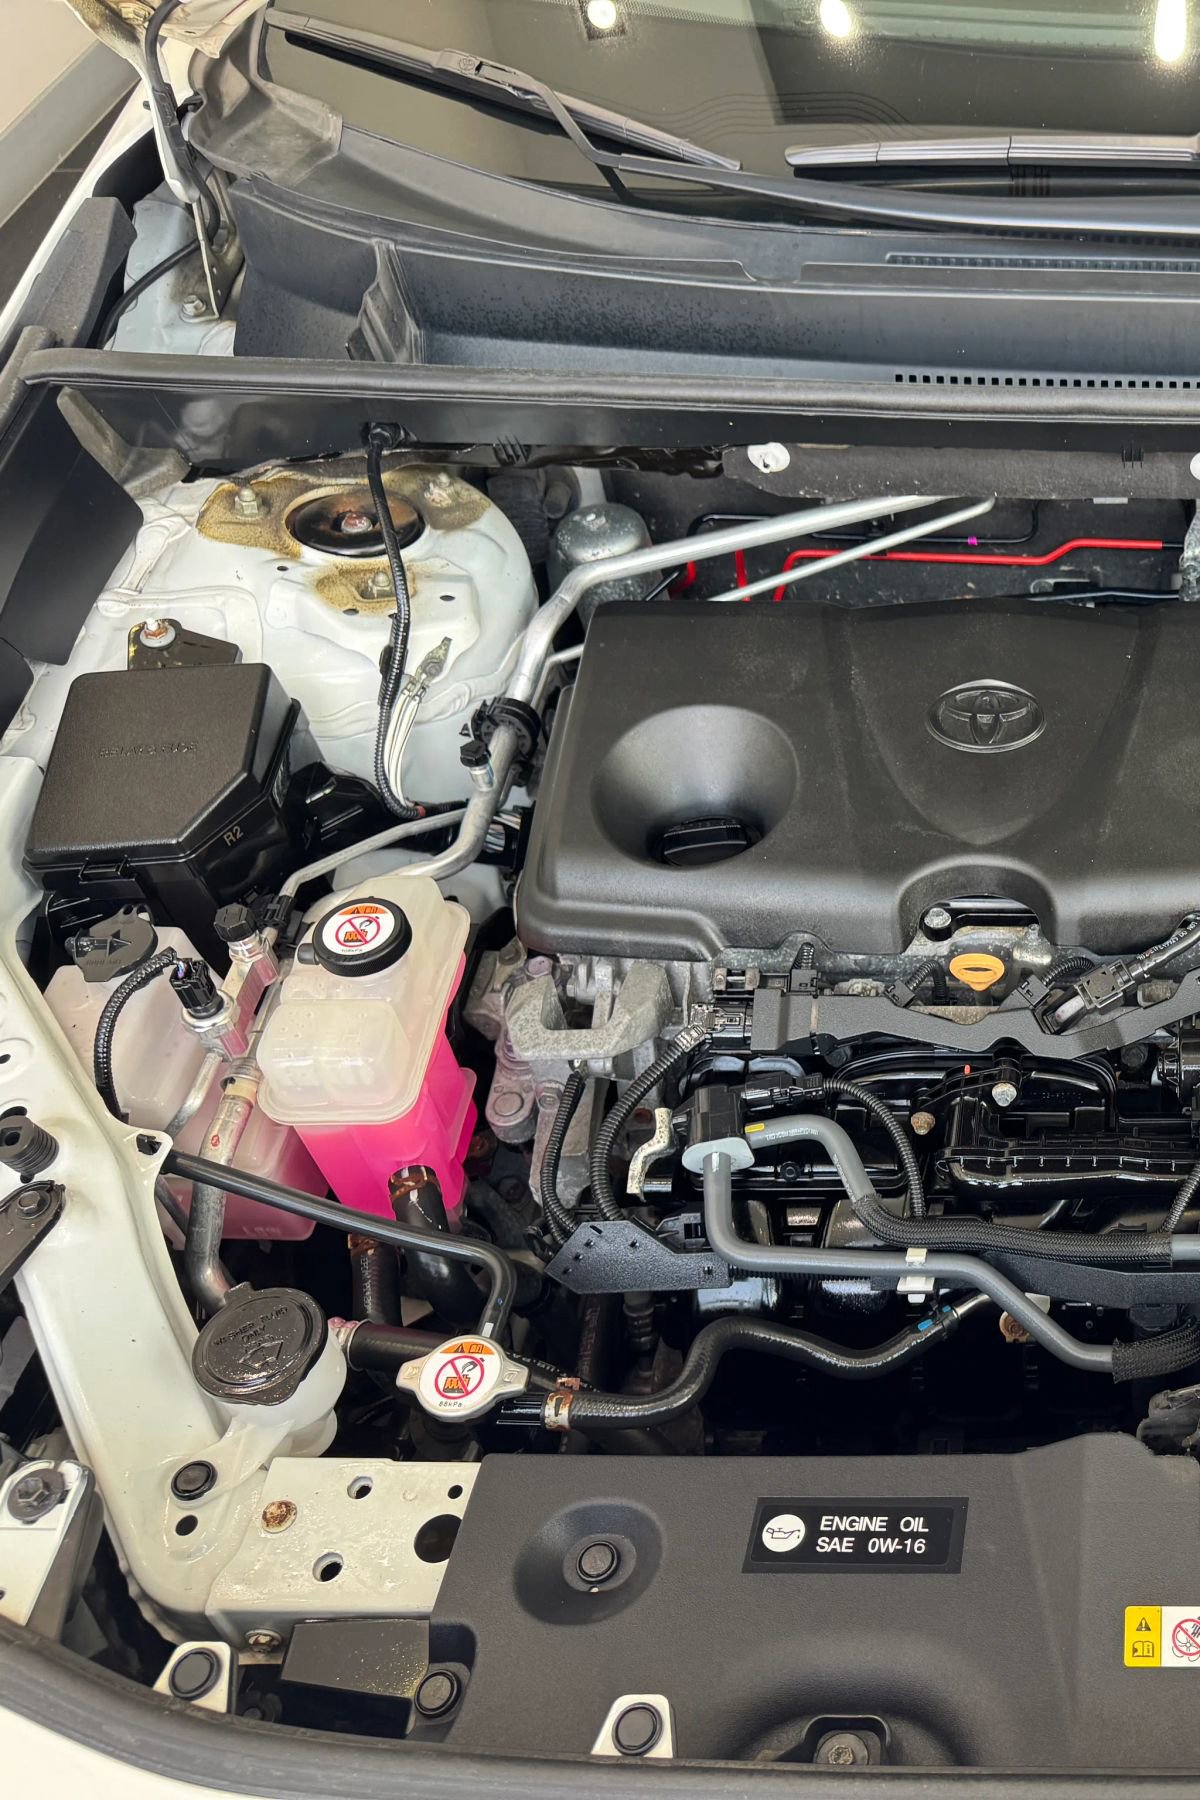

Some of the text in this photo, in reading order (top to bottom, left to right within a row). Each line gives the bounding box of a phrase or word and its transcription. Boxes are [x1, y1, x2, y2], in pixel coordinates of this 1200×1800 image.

[222, 825, 244, 847] R2
[820, 1515, 929, 1533] ENGINE OIL
[815, 1536, 926, 1554] SAE 0W-16
